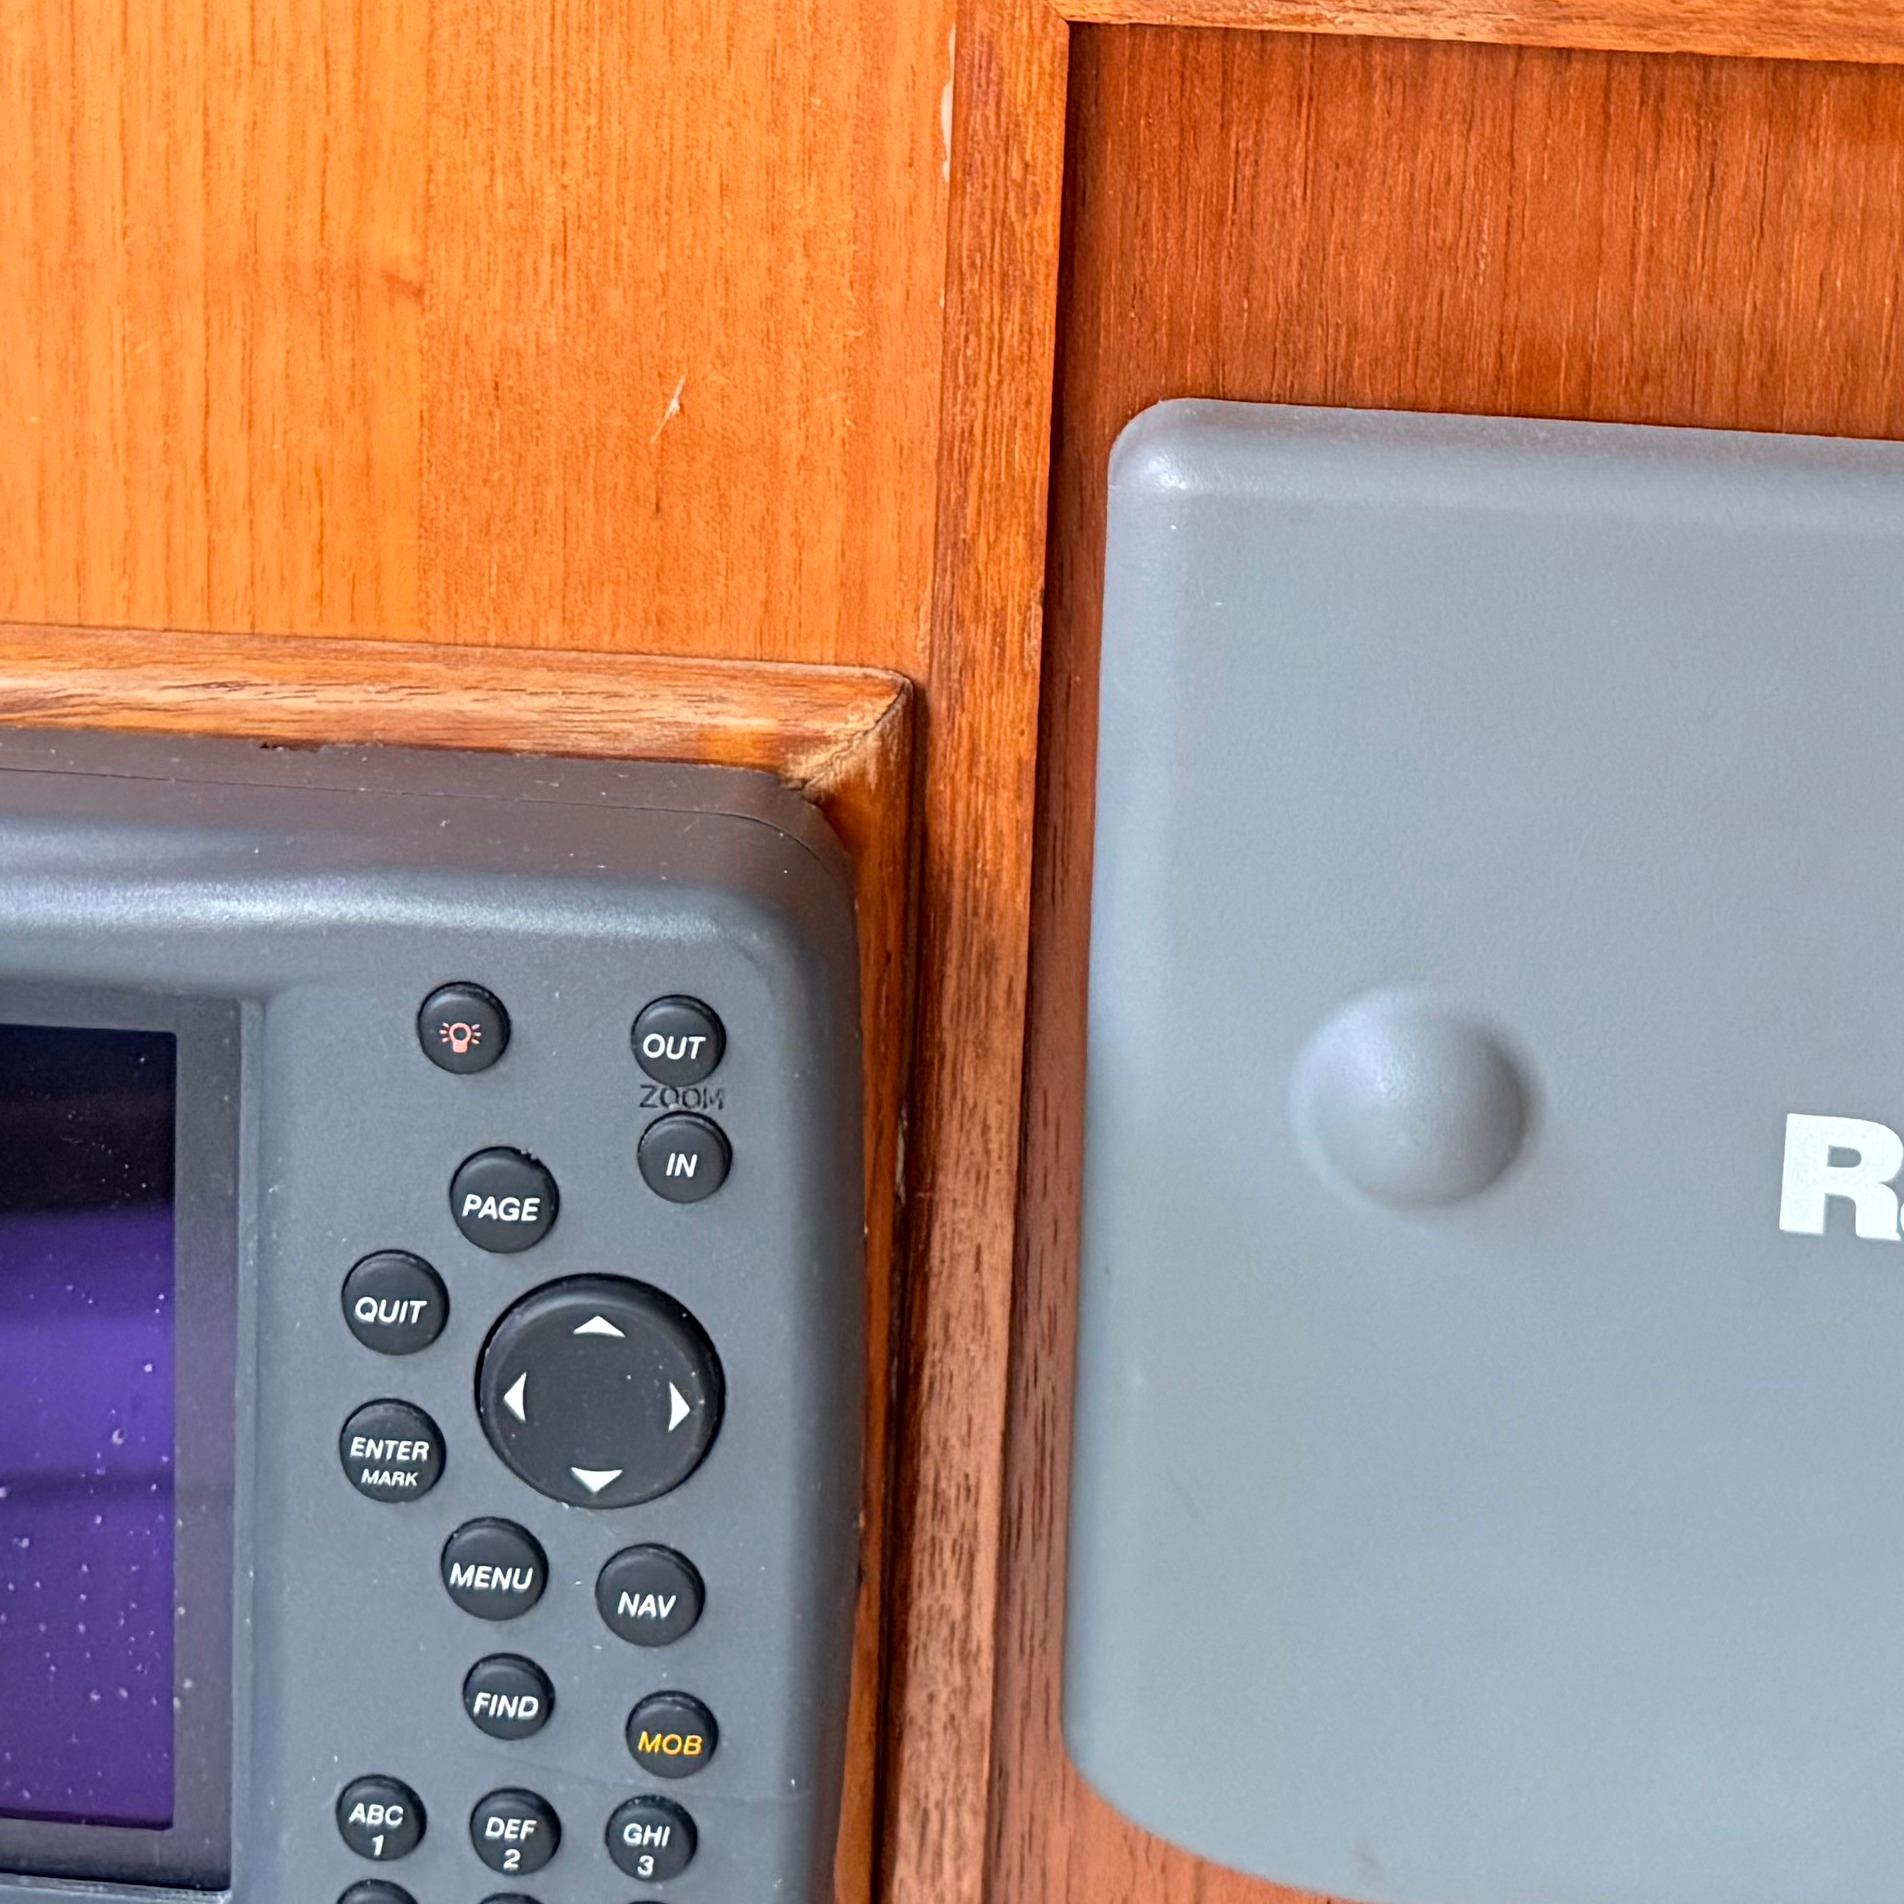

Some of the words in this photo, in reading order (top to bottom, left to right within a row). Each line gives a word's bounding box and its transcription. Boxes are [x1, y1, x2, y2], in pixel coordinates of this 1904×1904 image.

[642, 1033, 707, 1060] OUT
[639, 1085, 726, 1110] ZOOM
[665, 1153, 698, 1178] IN
[462, 1194, 541, 1223] PAGE
[354, 1297, 427, 1325] QUIT
[350, 1436, 430, 1462] ENTER
[360, 1468, 419, 1488] MARK
[449, 1562, 533, 1592] MENU
[618, 1592, 677, 1620] NAV
[473, 1692, 539, 1720] FIND
[638, 1731, 703, 1756] MOB
[348, 1804, 404, 1826] ABC
[485, 1816, 537, 1841] DEF
[623, 1823, 672, 1848] GHI
[371, 1834, 384, 1857] 1
[502, 1850, 522, 1869] 2
[637, 1855, 654, 1876] 3
